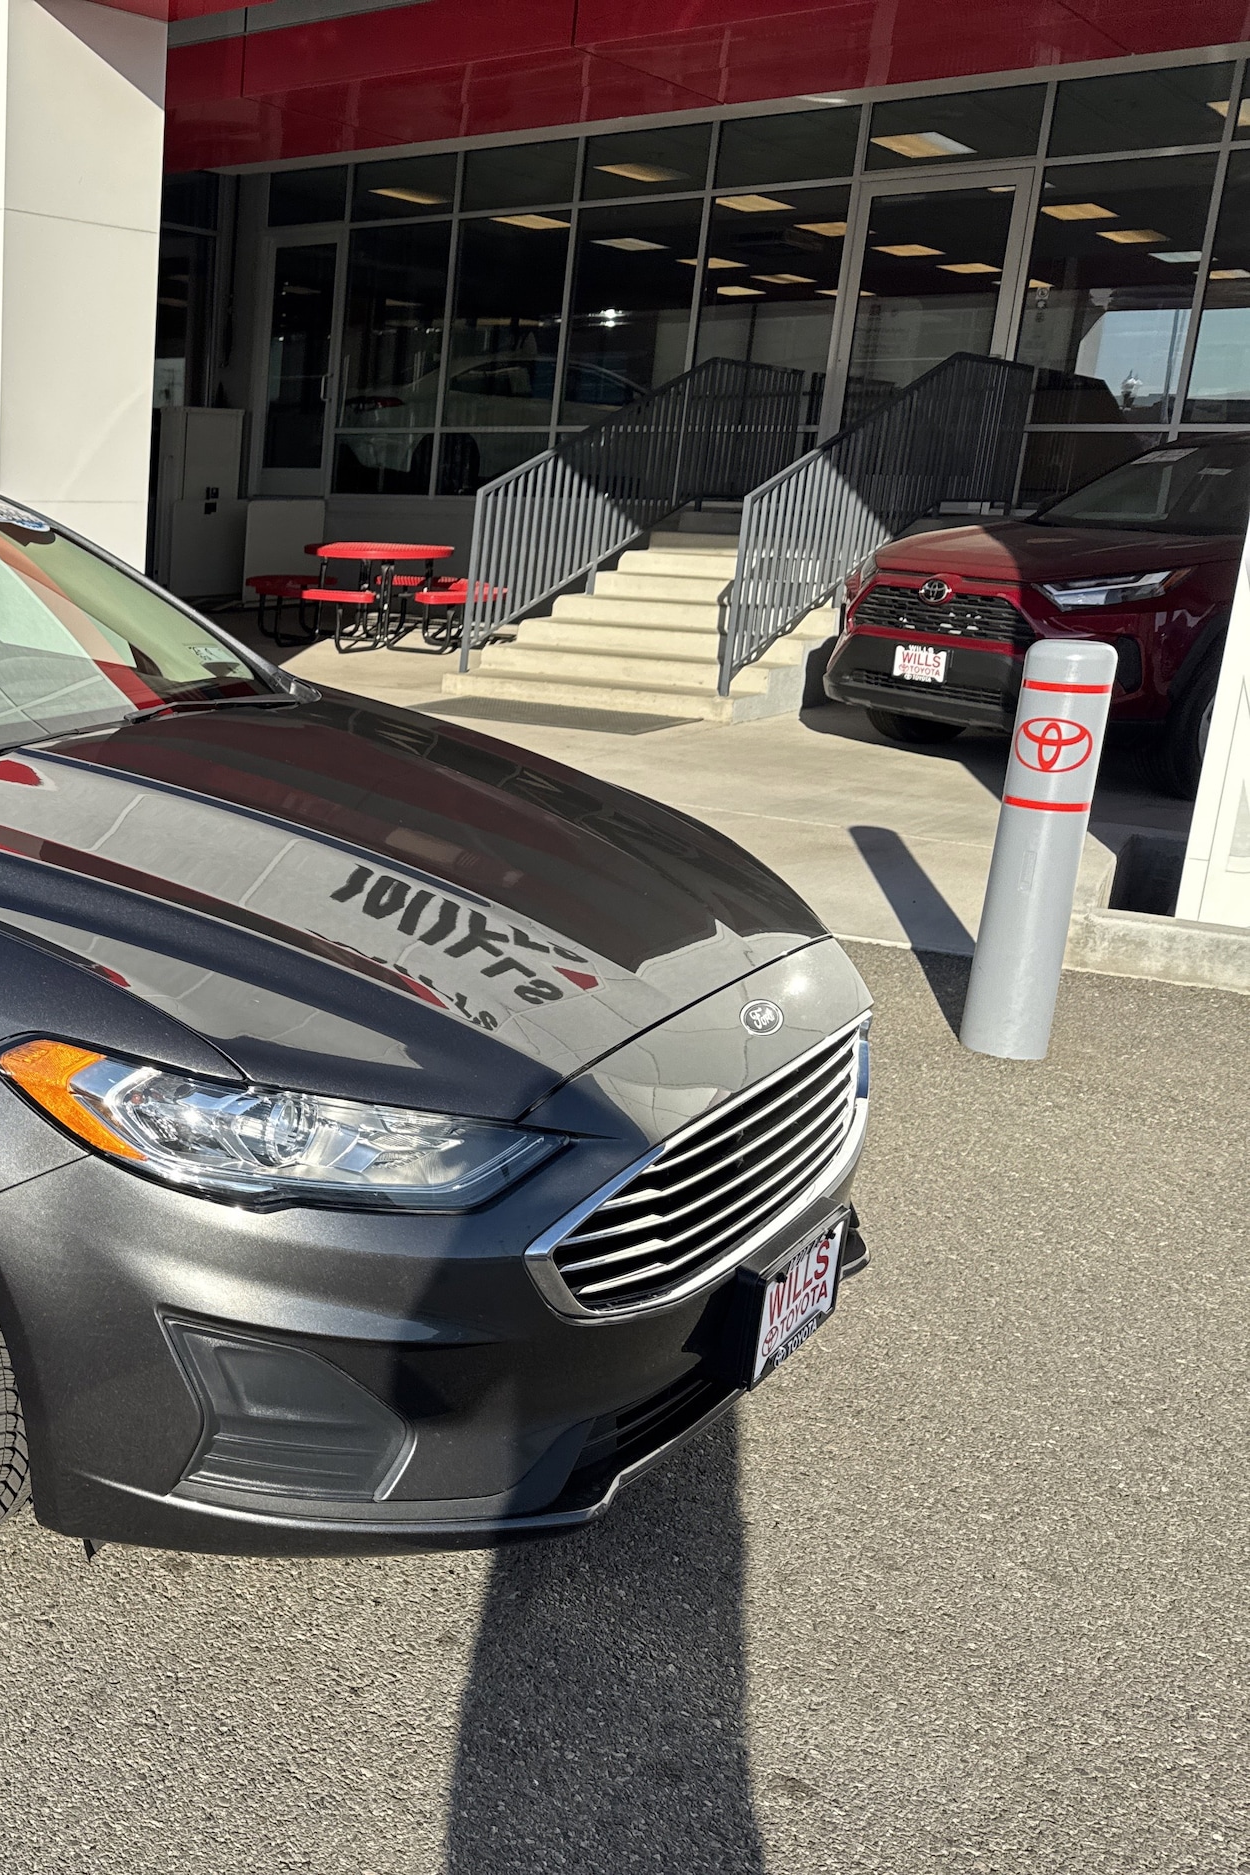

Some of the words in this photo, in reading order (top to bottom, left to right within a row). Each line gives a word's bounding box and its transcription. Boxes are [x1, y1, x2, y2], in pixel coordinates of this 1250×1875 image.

[902, 651, 941, 668] WILLS
[910, 665, 941, 677] TOYOTA
[768, 1238, 830, 1327] WILLS
[779, 1279, 828, 1340] TOYOTA
[787, 1317, 817, 1356] TOYOTA
